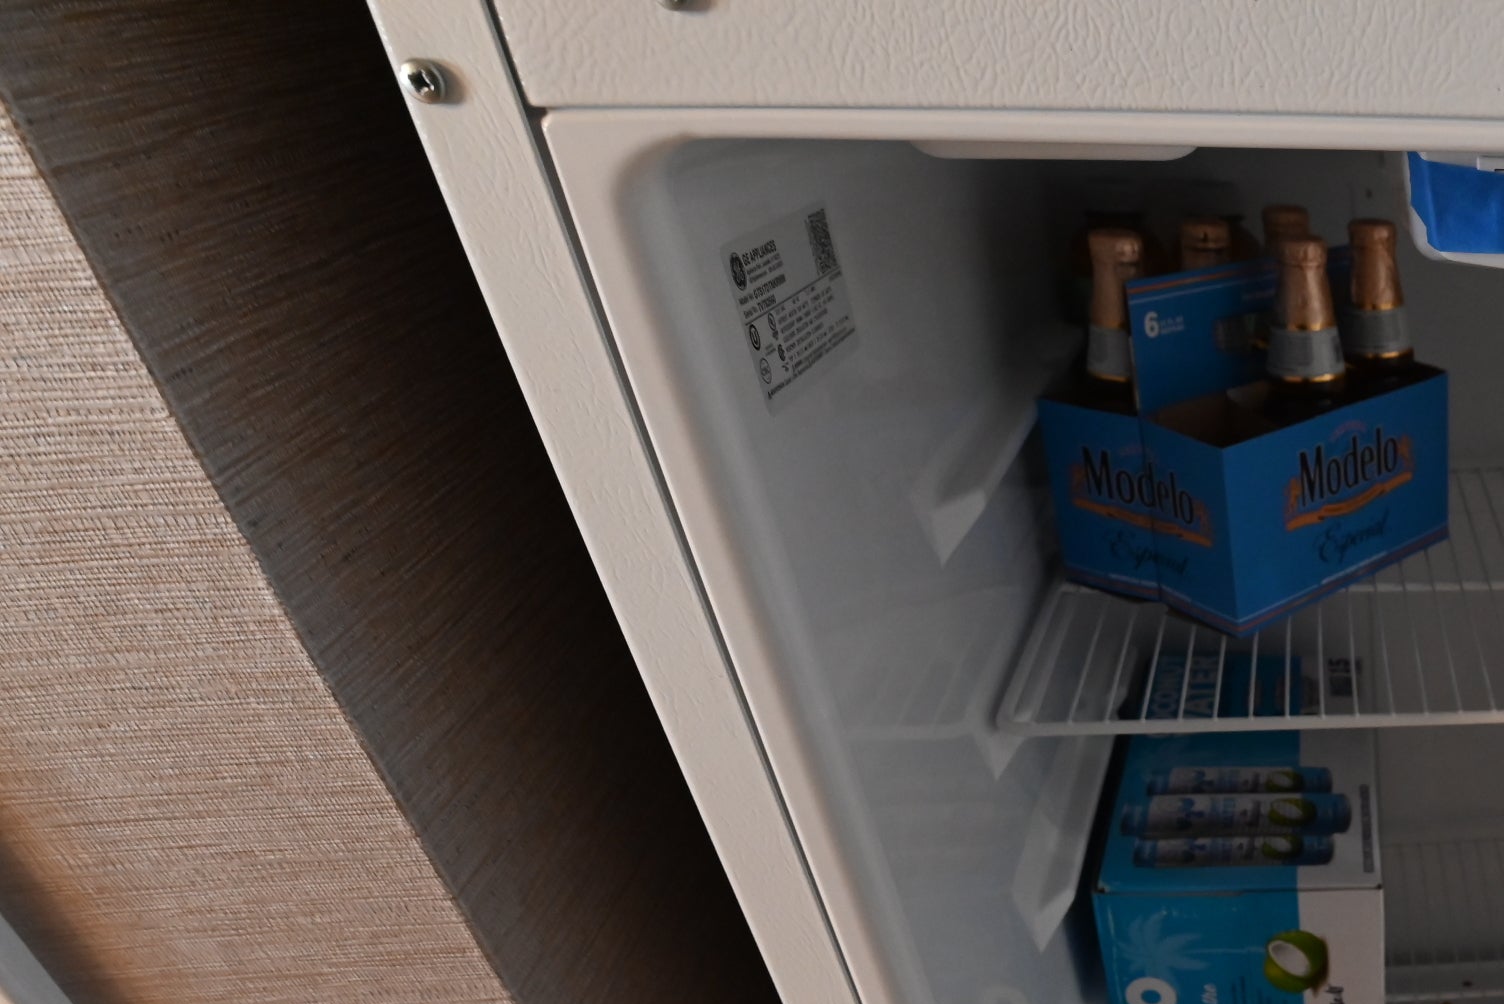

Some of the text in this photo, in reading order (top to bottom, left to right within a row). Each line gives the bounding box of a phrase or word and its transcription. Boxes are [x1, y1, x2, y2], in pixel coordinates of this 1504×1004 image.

[1144, 311, 1160, 338] 6
[1081, 446, 1195, 525] Modelo
[1299, 427, 1398, 508] Modelo
